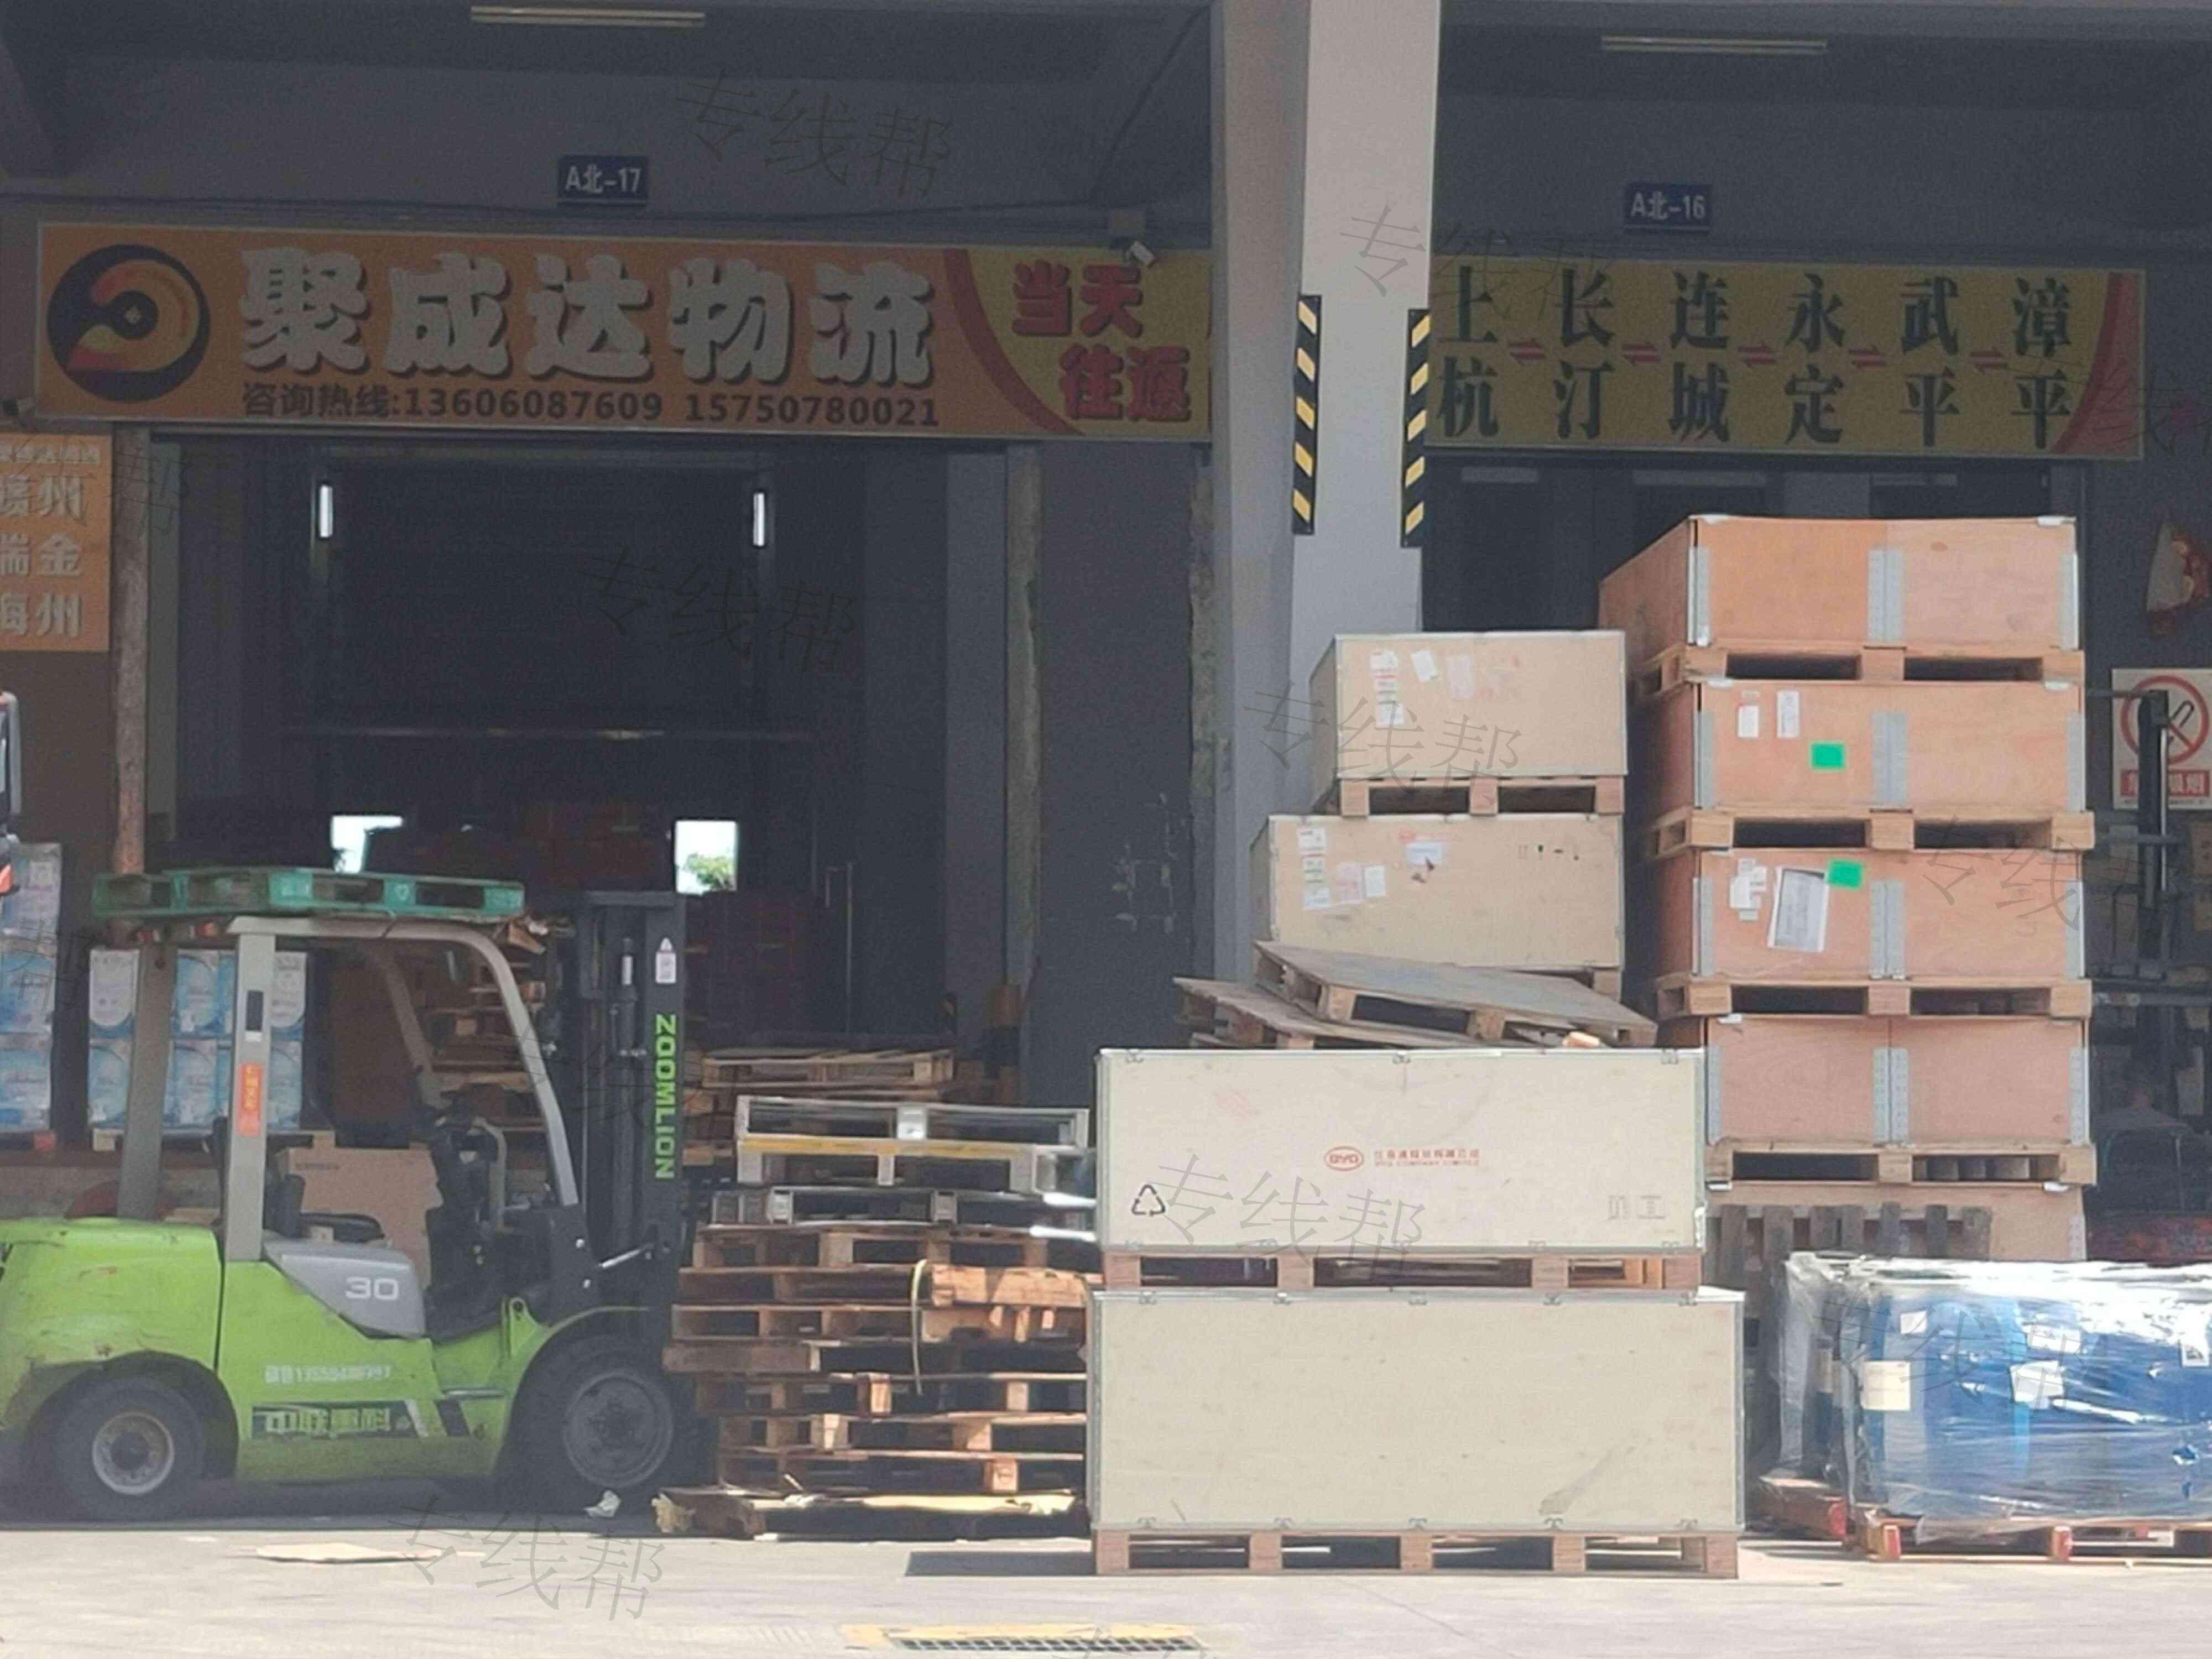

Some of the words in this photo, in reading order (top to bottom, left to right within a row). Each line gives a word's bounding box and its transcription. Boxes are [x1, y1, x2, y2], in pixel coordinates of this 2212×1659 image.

[566, 165, 641, 194] A北-17
[1631, 191, 1705, 220] A北-16
[239, 246, 935, 387] 聚成达物流
[1012, 260, 1144, 337] 当天
[1438, 265, 1499, 439] 上杭
[1552, 268, 1615, 441] 长汀
[1670, 270, 1731, 444] 连城
[1783, 272, 1846, 445] 永定
[1898, 275, 1960, 447] 武平
[2011, 277, 2072, 450] 漳平
[242, 383, 662, 420] 咨询热线:13606087609
[685, 393, 939, 426] 15750780021
[1059, 343, 1192, 422] 往返
[655, 1014, 677, 1179] ZOOMLION
[345, 1277, 400, 1301] 30
